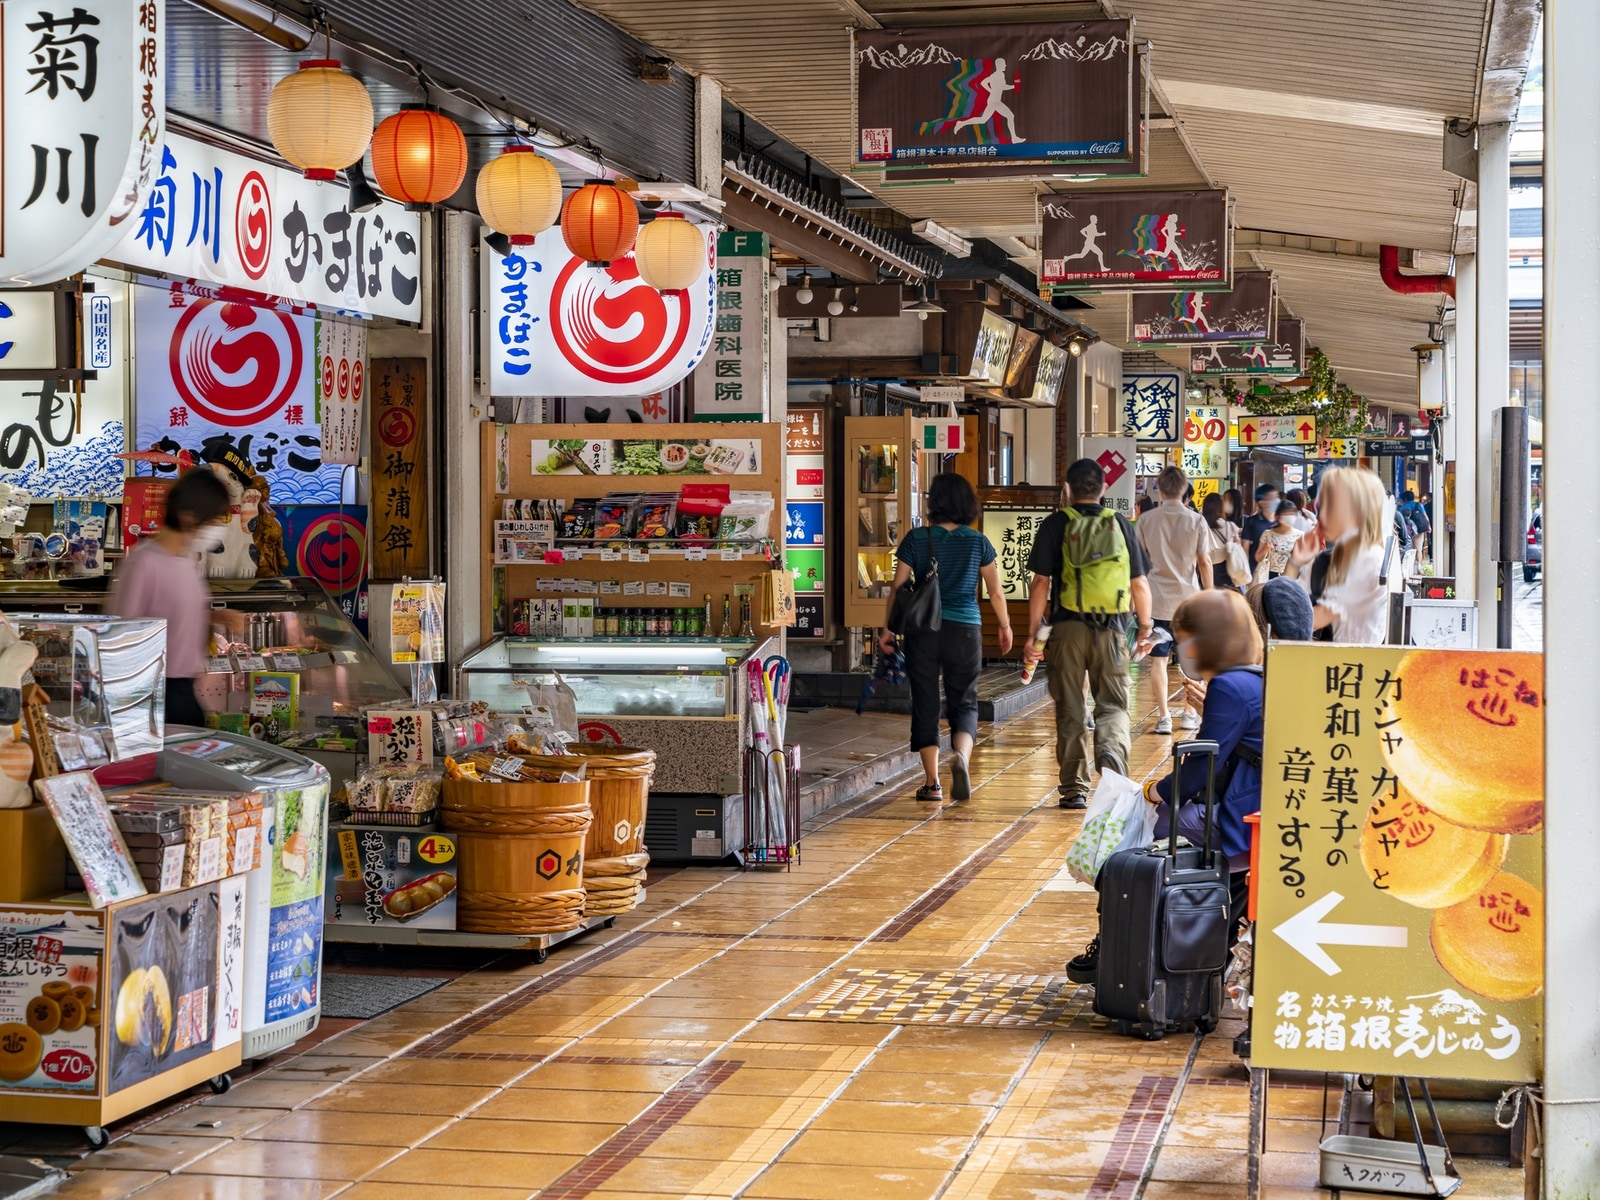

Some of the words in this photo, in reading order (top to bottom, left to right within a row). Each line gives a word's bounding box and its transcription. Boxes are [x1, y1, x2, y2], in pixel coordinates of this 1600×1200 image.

[21, 7, 101, 218] 菊川
[896, 146, 998, 159] 箱根湯本土産品店組合
[135, 144, 223, 264] 菊川
[283, 200, 418, 305] かまぼこ
[734, 235, 748, 252] F
[93, 299, 108, 364] 小田原名産
[498, 252, 542, 376] かまぼこ
[715, 267, 743, 401] 箱根歯科医院
[169, 407, 189, 428] 録
[284, 405, 304, 426] 標
[1260, 429, 1297, 441] プラレール
[381, 450, 416, 561] 御蒲鉾
[1001, 528, 1016, 594] まんじゅう
[1459, 667, 1539, 707] はこね
[395, 715, 416, 748] 極小
[1320, 662, 1363, 866] 昭和の菓子の
[1371, 669, 1403, 890] カシャカシャと
[1277, 747, 1315, 899] 音がする。
[1479, 892, 1531, 917] はこね
[1274, 990, 1302, 1050] 名物
[1305, 1003, 1522, 1060] 箱根まんじゅう
[1310, 992, 1395, 1014] カステラ焼
[1342, 1162, 1407, 1188] キクガワ
